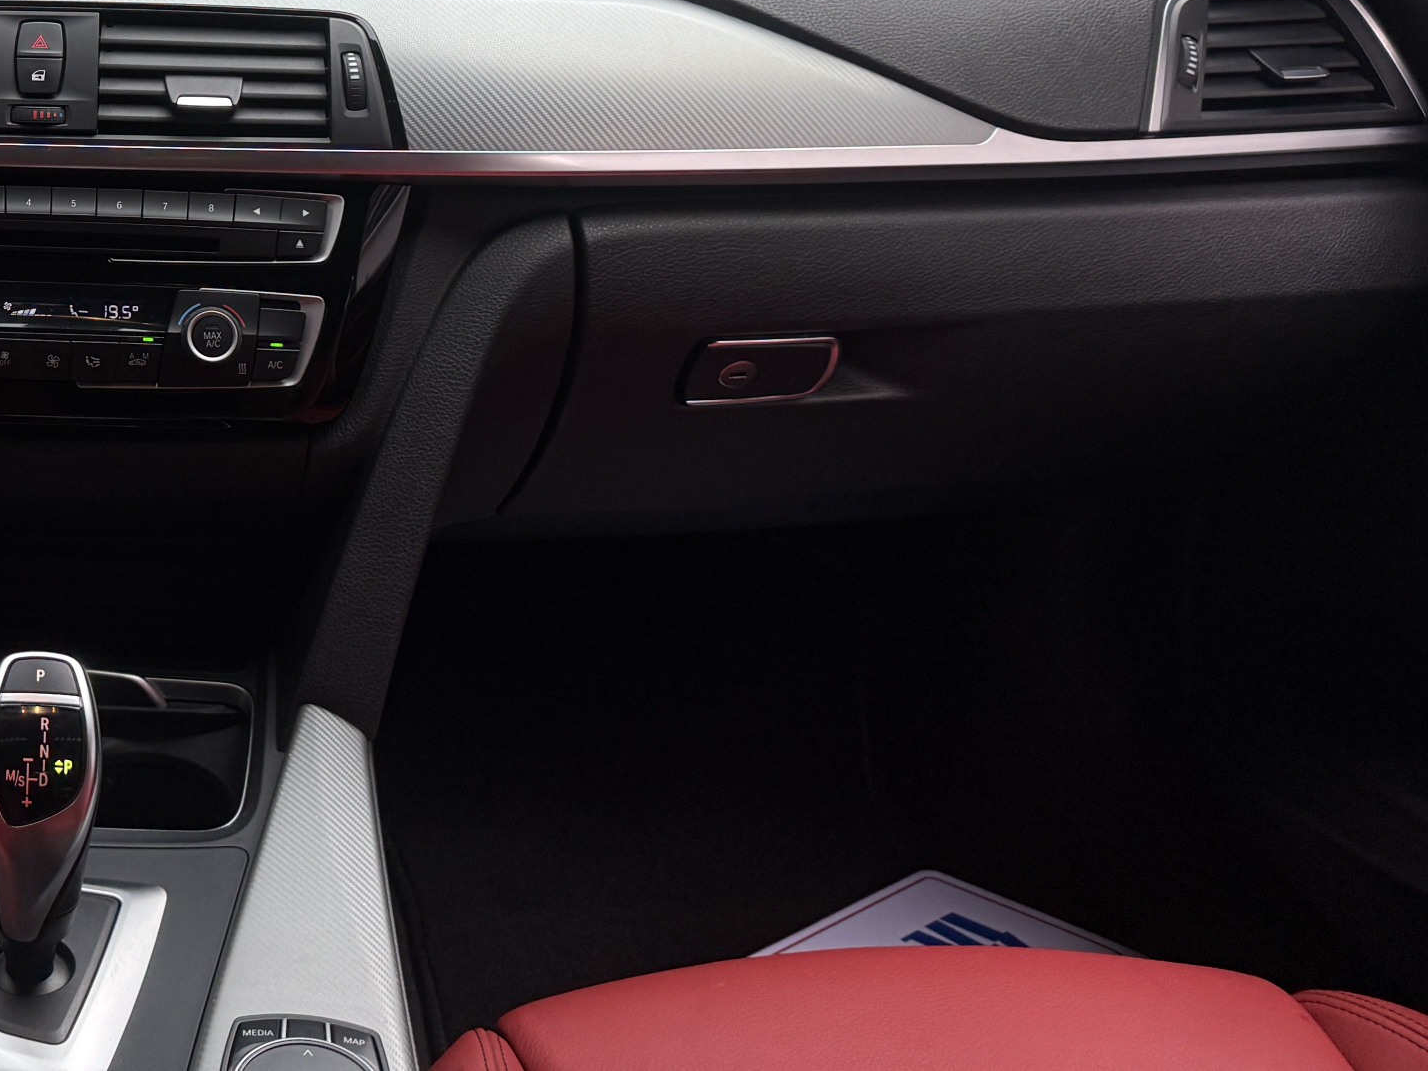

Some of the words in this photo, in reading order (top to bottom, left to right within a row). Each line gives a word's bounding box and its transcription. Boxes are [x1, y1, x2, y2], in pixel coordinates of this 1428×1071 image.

[26, 199, 32, 207] 4
[71, 200, 77, 208] 5
[116, 201, 122, 209] 6
[162, 202, 168, 211] 7
[208, 204, 214, 212] 8
[203, 331, 222, 340] MAX
[206, 340, 220, 349] A/C
[267, 360, 283, 370] A/C
[36, 669, 45, 682] P
[40, 717, 49, 731] R
[39, 744, 49, 759] N
[64, 759, 73, 775] P
[39, 772, 48, 787] D
[242, 1029, 274, 1037] MEDIA
[343, 1036, 365, 1046] MAP
